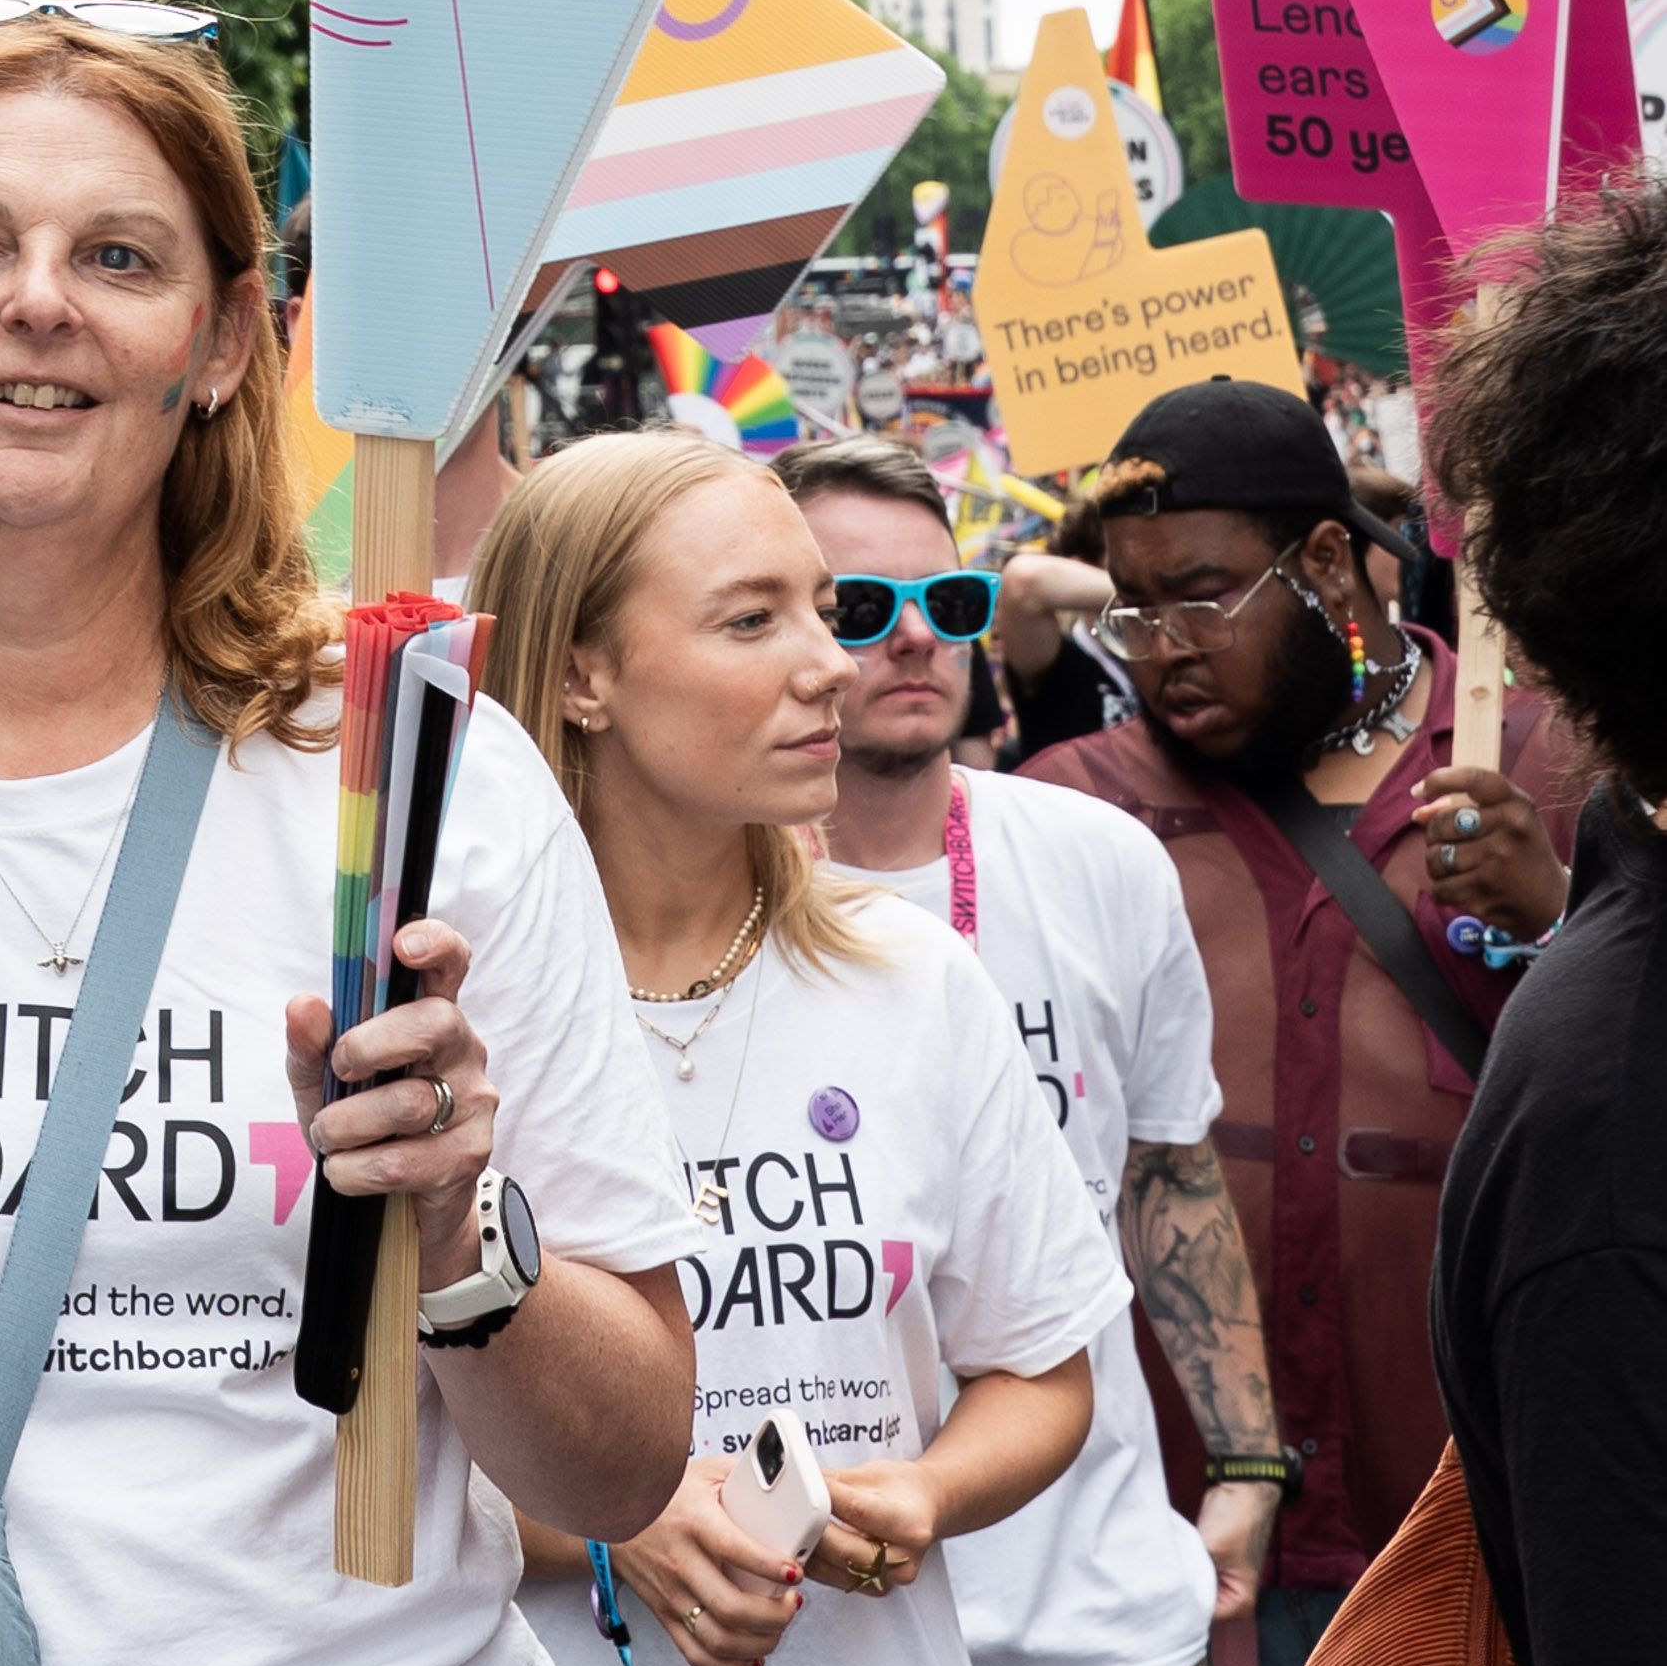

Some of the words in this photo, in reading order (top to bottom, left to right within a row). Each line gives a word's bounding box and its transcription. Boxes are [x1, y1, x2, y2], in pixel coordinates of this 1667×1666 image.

[1258, 64, 1370, 99] ears
[1266, 114, 1333, 158] 50
[995, 299, 1130, 353] There's
[1140, 274, 1255, 329] power
[1013, 366, 1046, 394] in
[1055, 344, 1157, 386] being
[1165, 309, 1282, 361] heard.
[108, 1284, 175, 1316] the
[186, 1287, 294, 1319] word.
[41, 1340, 295, 1373] itchboard.l
[694, 1378, 791, 1416] Spread
[799, 1375, 836, 1400] the
[840, 1378, 891, 1399] wor
